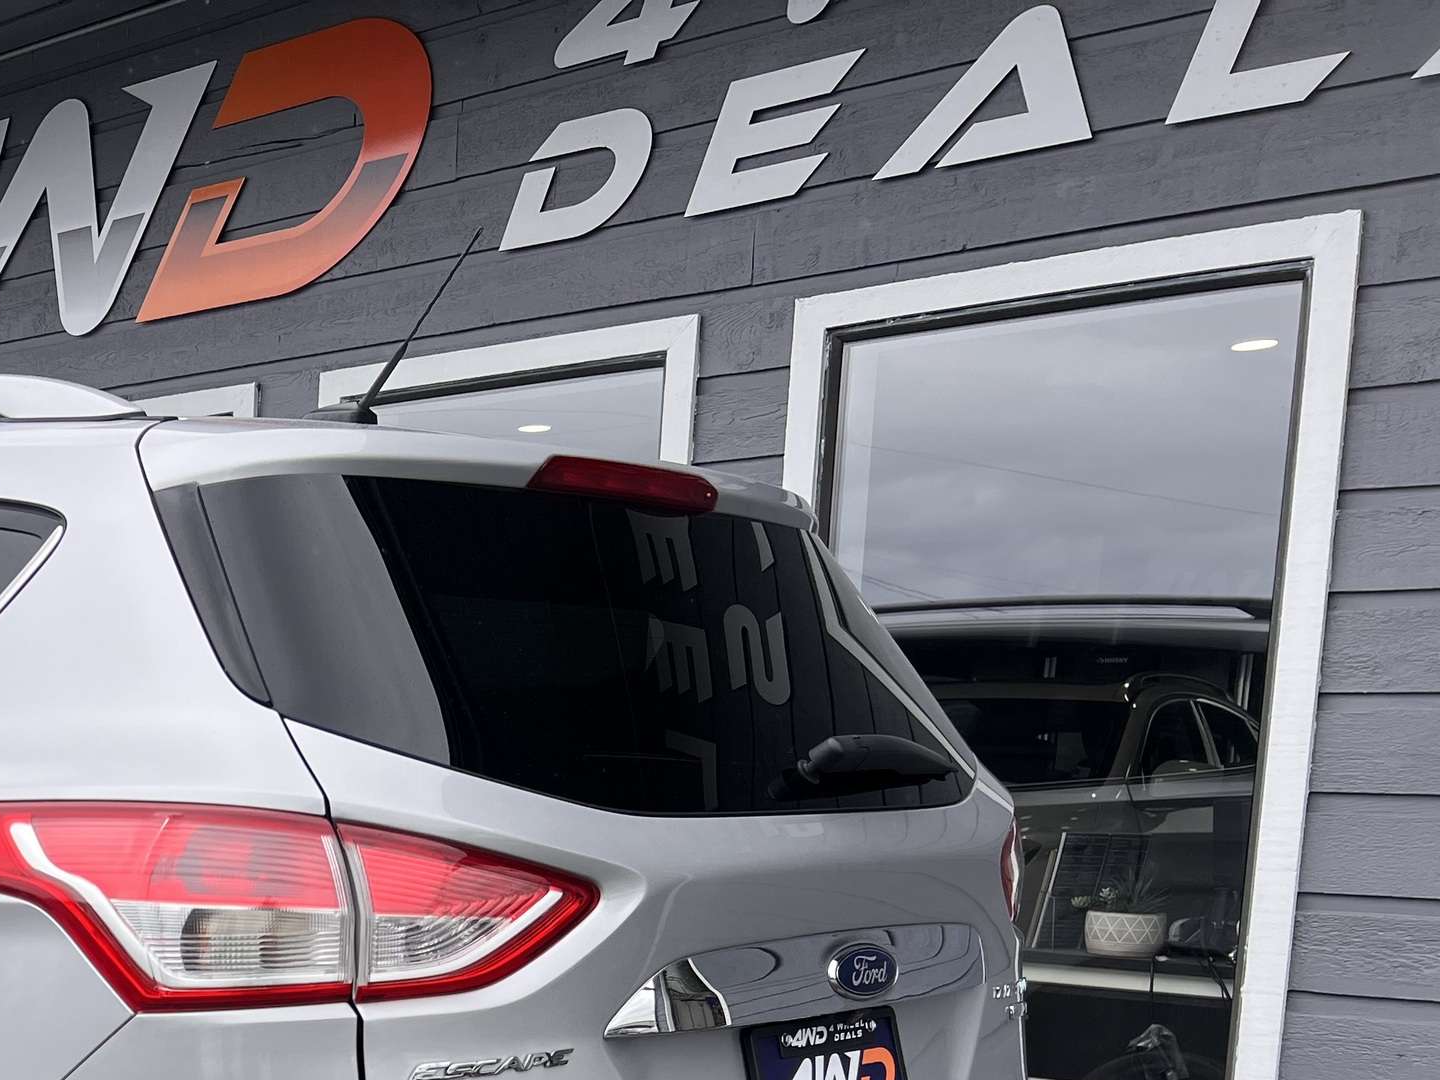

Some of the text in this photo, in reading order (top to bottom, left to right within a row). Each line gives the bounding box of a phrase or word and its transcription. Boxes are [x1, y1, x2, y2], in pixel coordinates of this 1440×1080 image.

[499, 0, 1440, 252] DEAL
[851, 955, 888, 987] Ford
[791, 1025, 828, 1048] 4WD
[833, 1029, 863, 1042] DEALS
